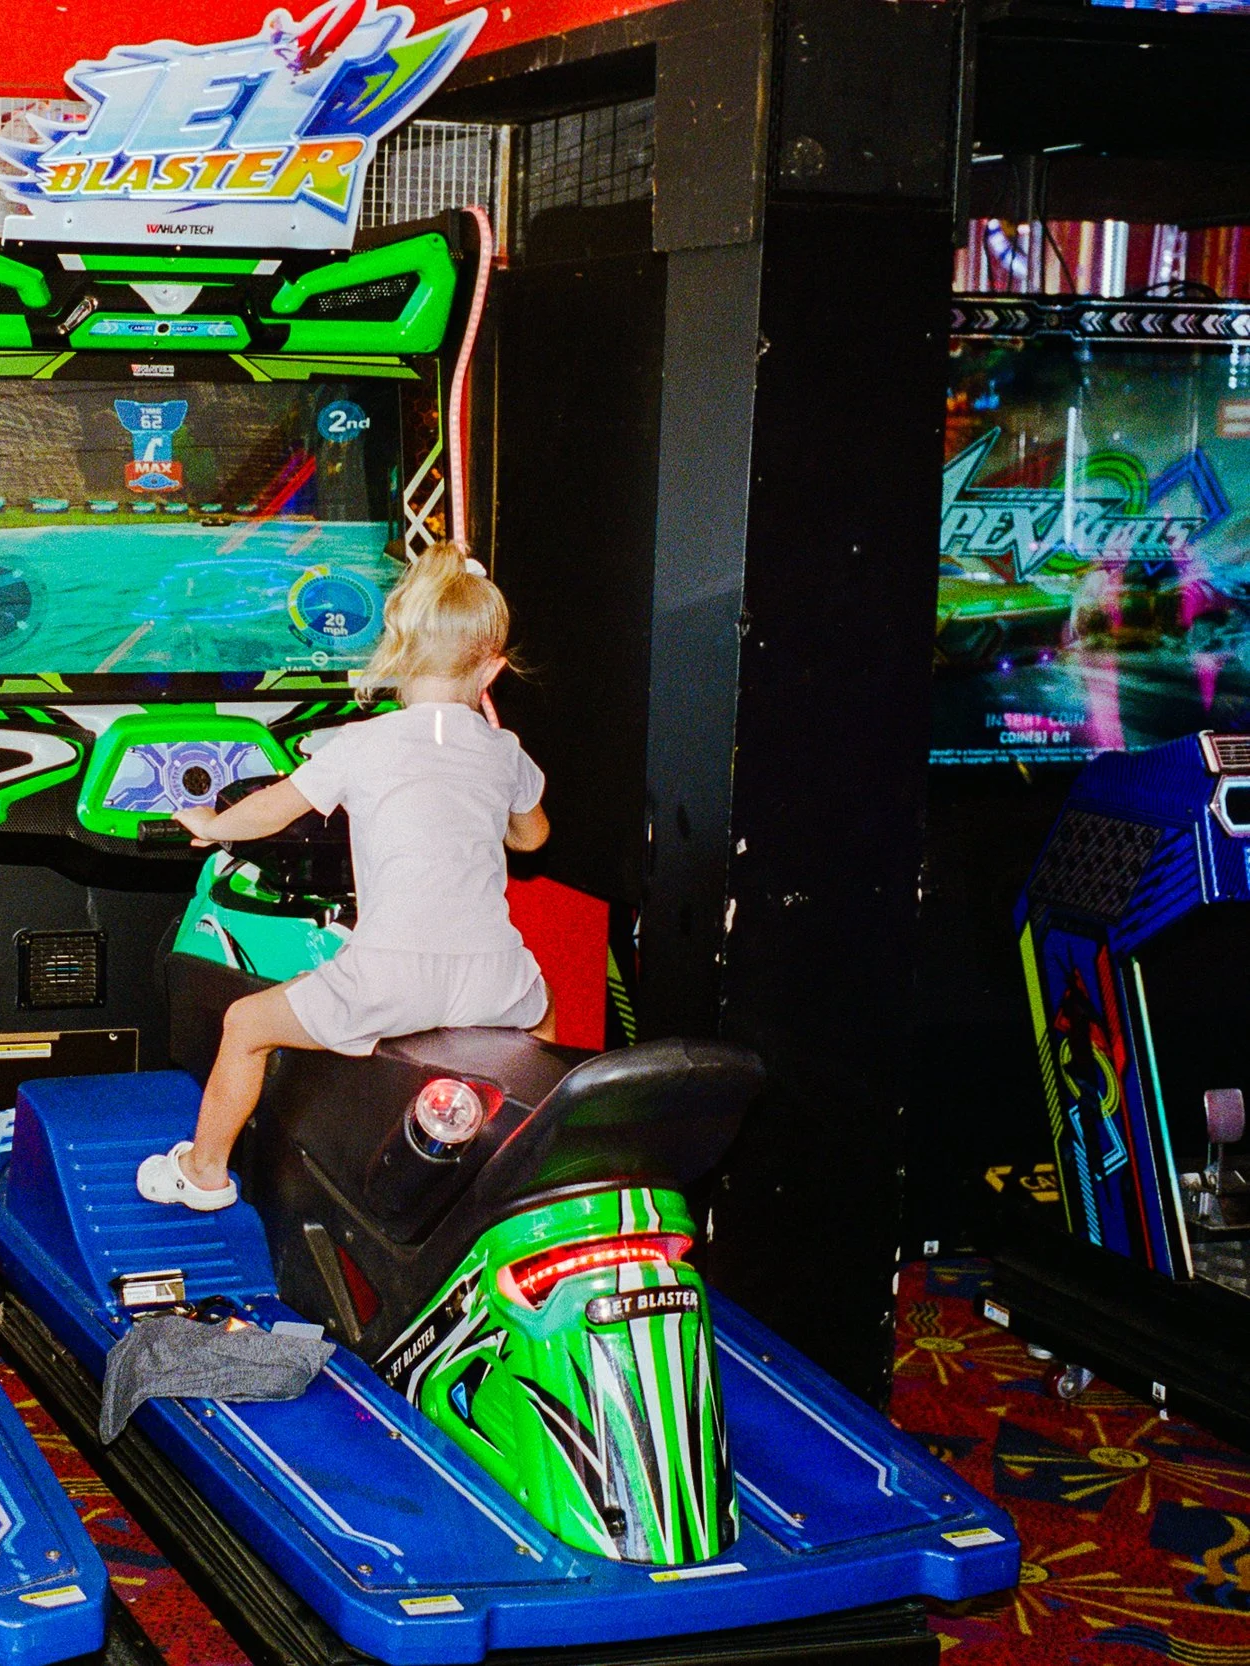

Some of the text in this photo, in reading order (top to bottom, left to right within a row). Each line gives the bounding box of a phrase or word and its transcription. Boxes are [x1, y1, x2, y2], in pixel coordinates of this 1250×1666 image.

[46, 14, 402, 159] JET
[44, 141, 364, 209] BLASTER
[146, 224, 214, 235] WAHLAP TECH
[140, 415, 162, 429] 62
[328, 410, 370, 433] 2nd
[134, 463, 172, 473] MAX
[325, 613, 346, 626] 20
[323, 627, 349, 637] mph
[637, 1291, 699, 1310] BLASTER
[403, 1325, 436, 1368] BLASTER
